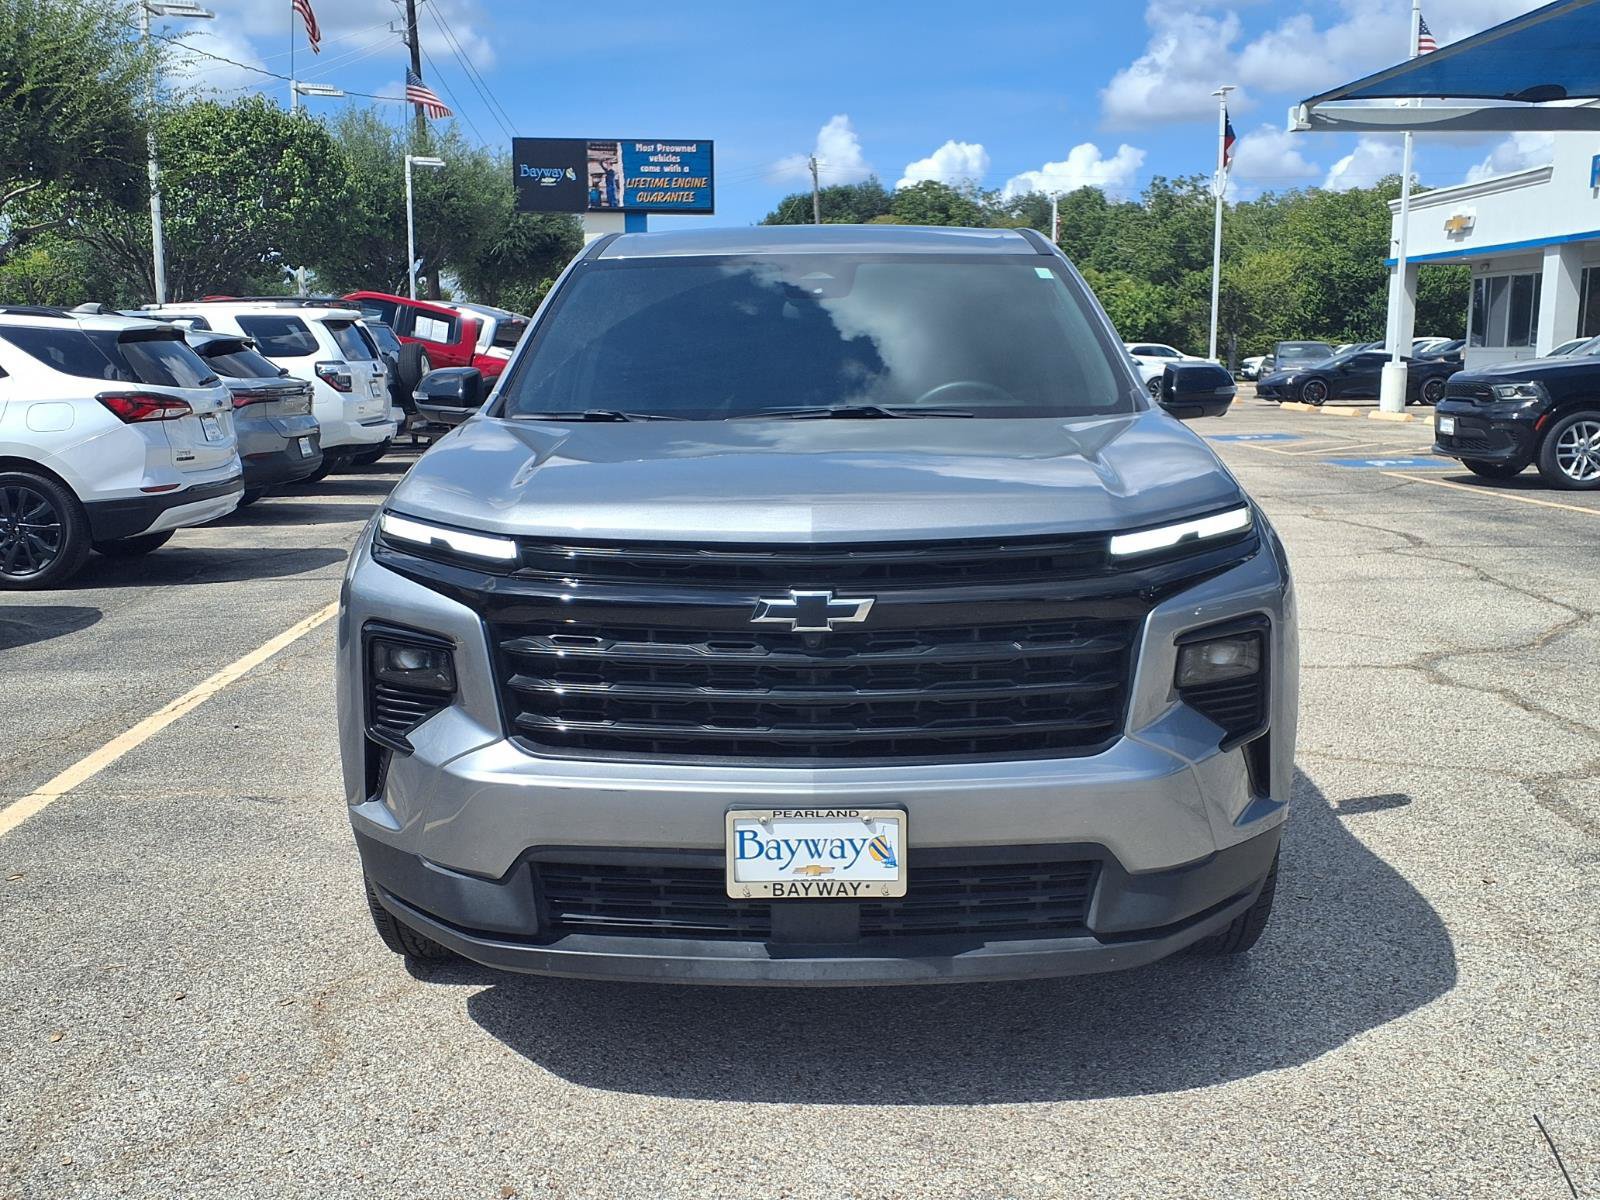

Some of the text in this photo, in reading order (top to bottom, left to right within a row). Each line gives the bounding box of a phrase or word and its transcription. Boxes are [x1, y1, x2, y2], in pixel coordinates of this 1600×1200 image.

[635, 143, 697, 153] Most Preowned
[649, 153, 681, 163] vehicles
[519, 163, 566, 182] Bayway
[640, 164, 690, 173] come with a
[626, 177, 709, 188] LIFETIME ENGINE
[636, 191, 696, 203] GUARANTEE
[772, 809, 860, 818] PEARLAND
[735, 829, 870, 872] Bayway
[772, 882, 862, 897] BAYWAY
